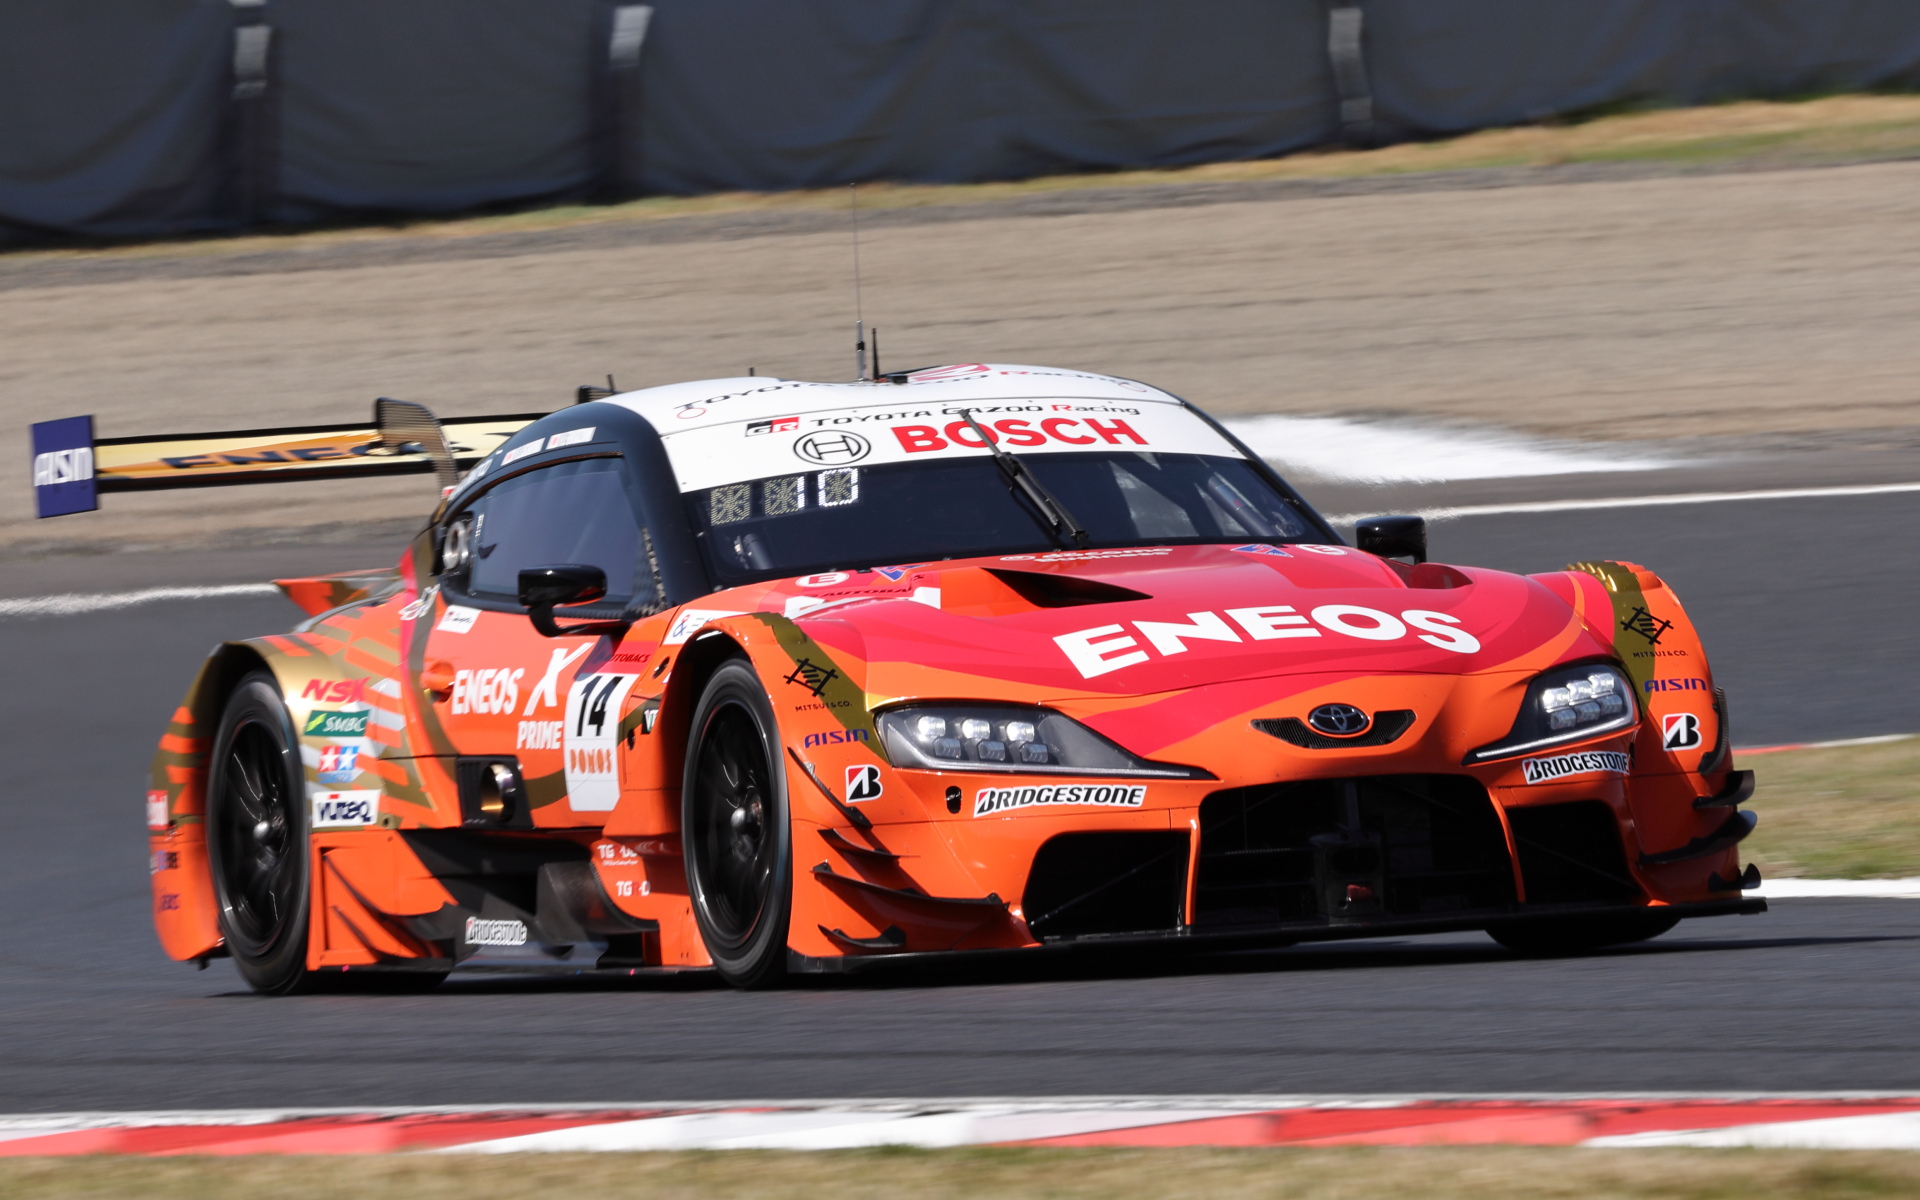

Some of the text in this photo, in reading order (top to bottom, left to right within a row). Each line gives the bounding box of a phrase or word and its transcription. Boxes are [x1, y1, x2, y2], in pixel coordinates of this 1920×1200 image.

[810, 403, 1141, 426] TOYOTA GAZOO Racing
[891, 417, 1150, 454] BOSCH
[1052, 604, 1481, 679] ENEOS
[301, 677, 371, 703] NSK
[451, 668, 525, 715] ENEOS
[1643, 678, 1707, 693] AISIN
[576, 675, 624, 738] 14
[322, 716, 368, 733] SMBC
[515, 720, 564, 750] PRIME
[803, 728, 869, 749] AISIN
[568, 748, 612, 775] PONOS
[1523, 751, 1630, 783] BRIDGESTONE
[976, 786, 1145, 815] BRIDGESTONE
